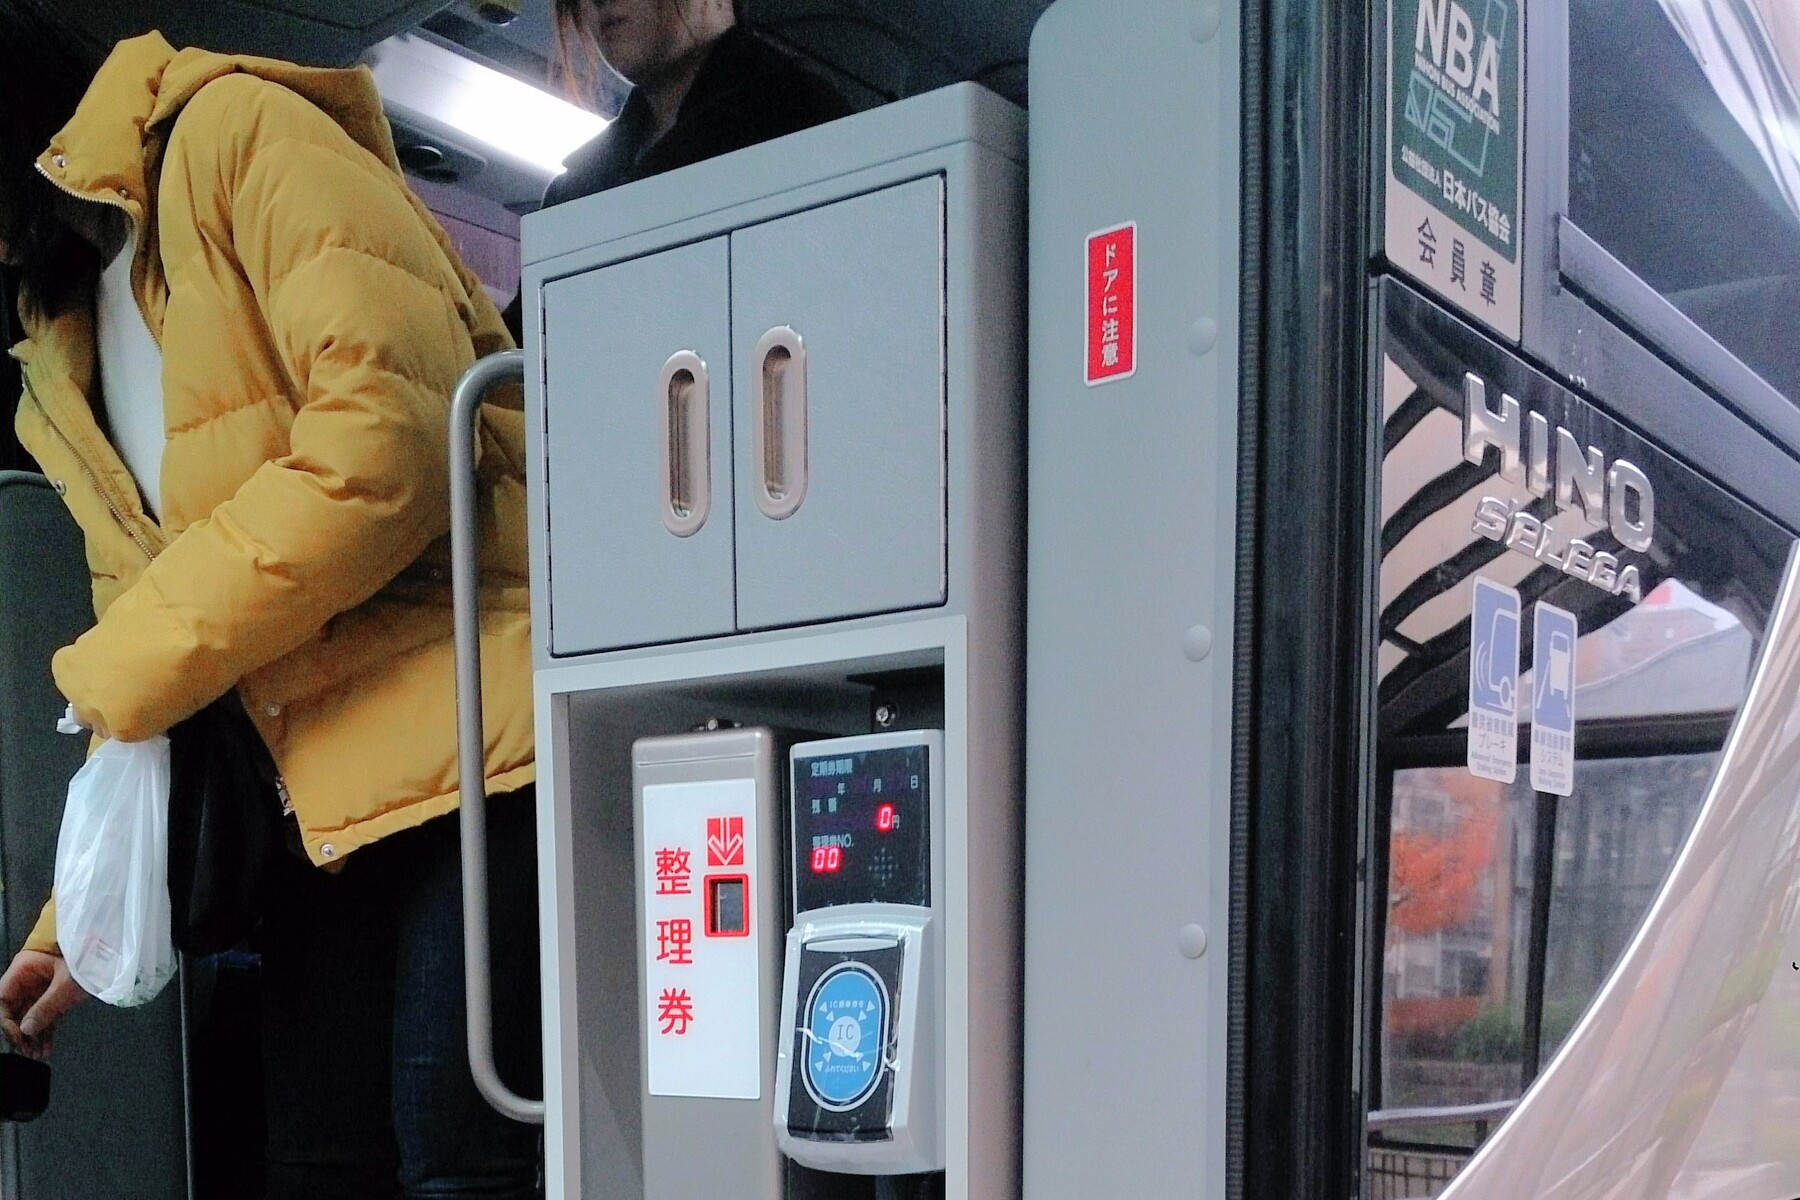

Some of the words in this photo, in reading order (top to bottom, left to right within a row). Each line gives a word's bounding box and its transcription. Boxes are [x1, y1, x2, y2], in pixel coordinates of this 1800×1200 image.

[1415, 0, 1500, 119] NBA
[1443, 169, 1511, 245] 日本バス協会
[1101, 243, 1119, 367] ドアに注意
[1417, 216, 1497, 307] 会員章
[1463, 371, 1655, 553] HINO
[1471, 496, 1642, 603] SELEGA
[837, 782, 846, 795] 年
[873, 778, 882, 792] 月
[910, 774, 918, 789] 日
[1478, 732, 1506, 753] ブレーキ
[813, 847, 840, 871] 00
[655, 847, 693, 1035] 整理券
[837, 1024, 854, 1040] IC
